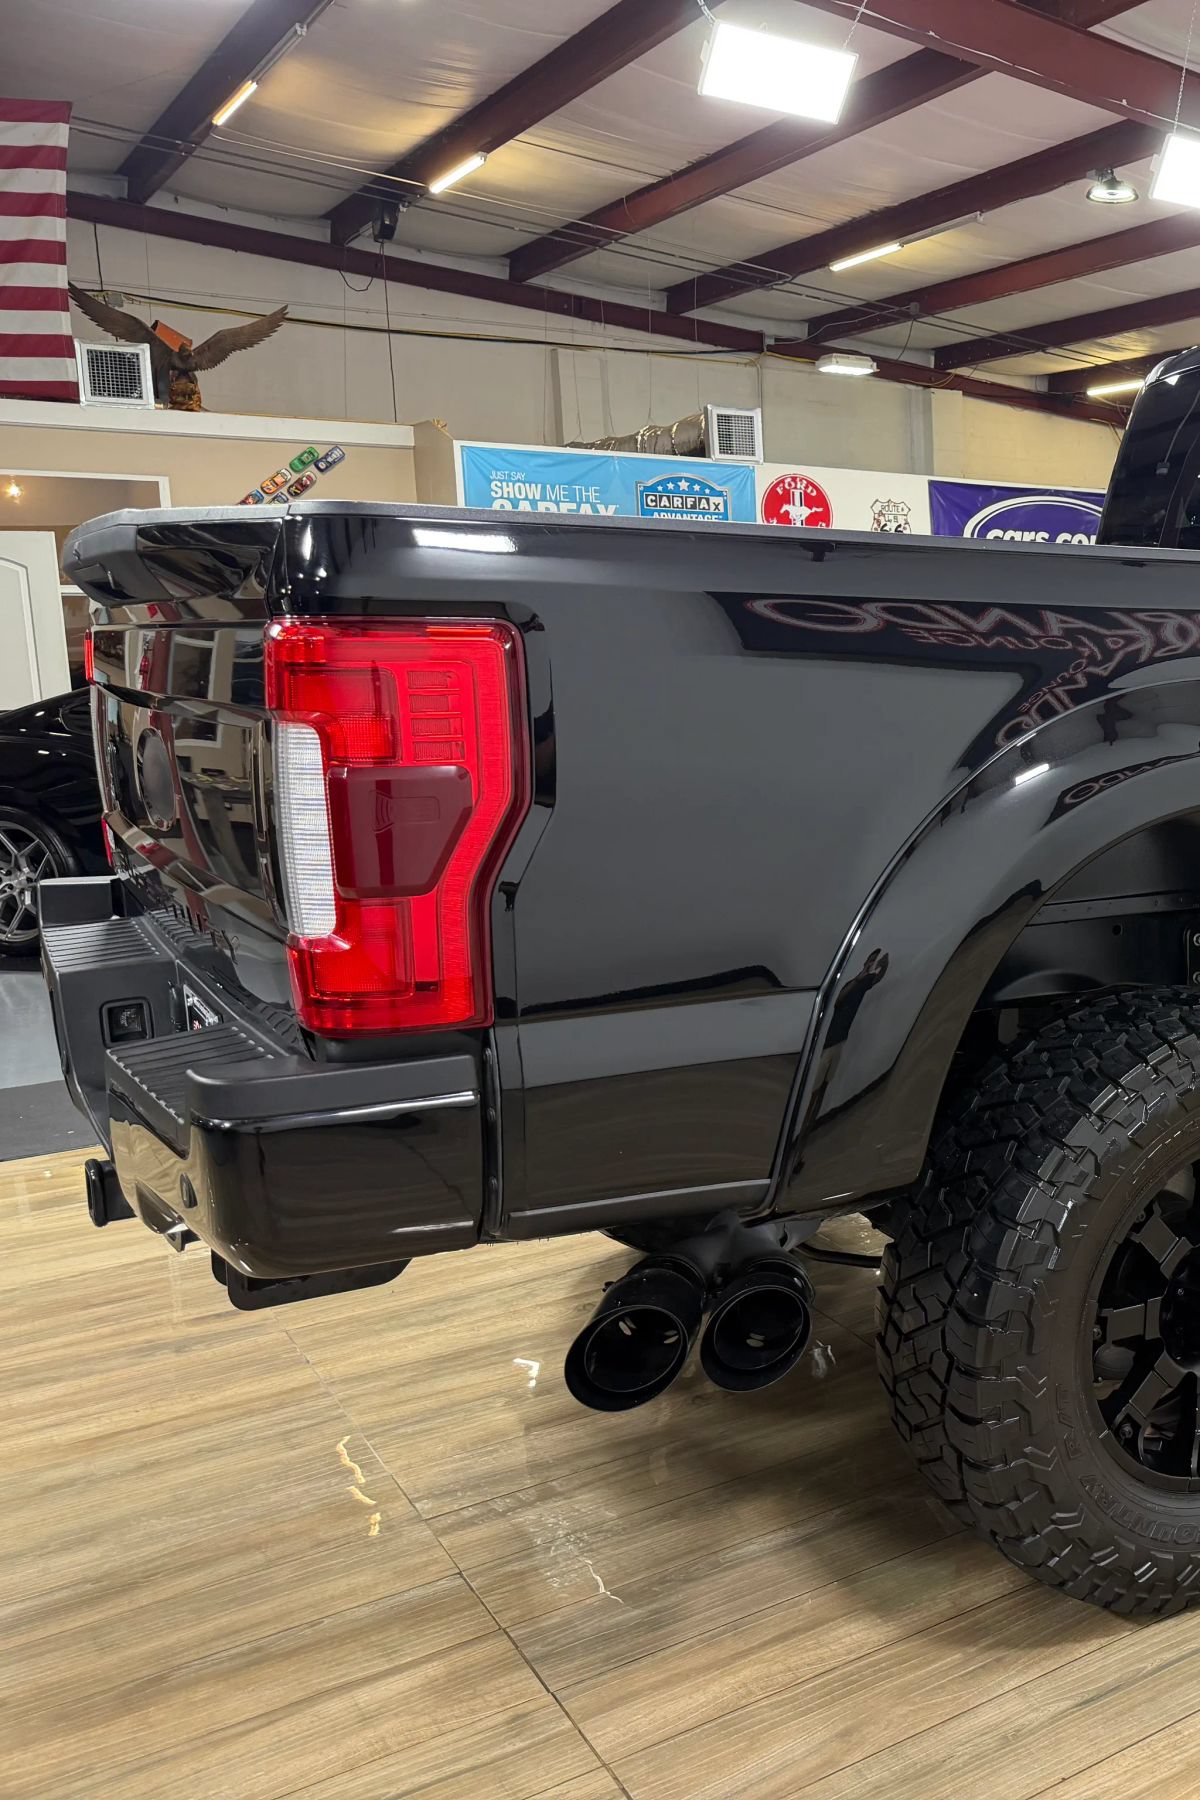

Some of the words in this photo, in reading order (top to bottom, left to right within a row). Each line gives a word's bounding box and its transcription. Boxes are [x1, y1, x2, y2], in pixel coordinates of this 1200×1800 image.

[490, 470, 510, 480] JUST
[511, 471, 526, 481] SAY
[490, 480, 542, 500] SHOW
[546, 484, 569, 501] ME
[572, 485, 600, 503] THE
[775, 477, 817, 496] FORD
[645, 494, 722, 512] CARFAX
[881, 504, 901, 513] ROUTE
